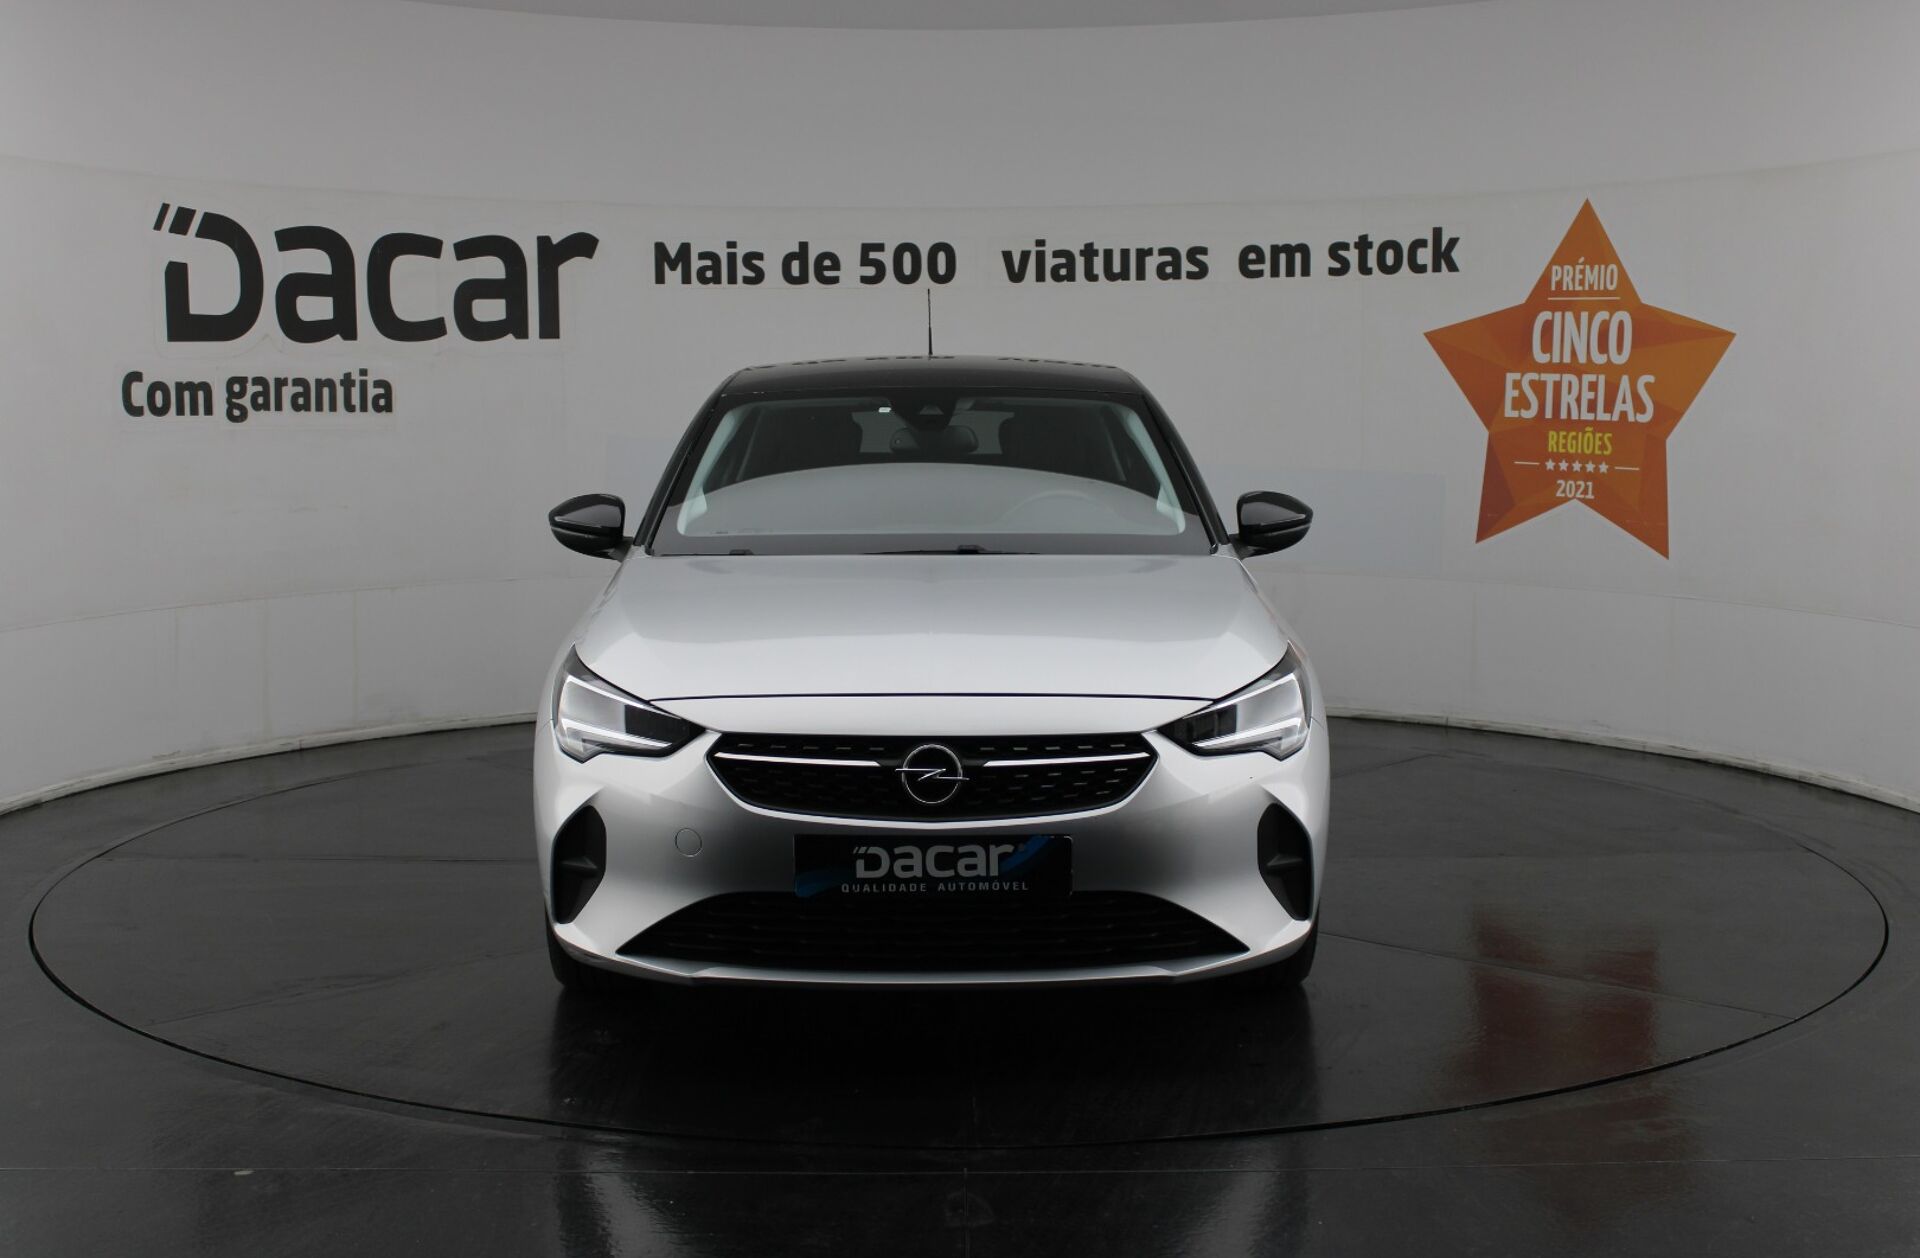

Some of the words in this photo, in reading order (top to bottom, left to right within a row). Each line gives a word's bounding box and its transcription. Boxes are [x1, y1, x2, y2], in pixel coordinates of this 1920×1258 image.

[153, 203, 599, 343] Dacar
[653, 241, 766, 285] Mais
[781, 241, 841, 285] de
[859, 241, 957, 285] 500
[1001, 239, 1209, 283] viaturas
[1238, 242, 1311, 279] em
[1327, 227, 1460, 276] stock
[1551, 257, 1618, 291] PRÉMIO
[1532, 311, 1633, 365] CINCO
[121, 371, 213, 417] Com
[225, 368, 393, 423] garantia
[1504, 372, 1655, 423] ESTRELAS
[1548, 426, 1613, 455] REGIÕES
[1556, 480, 1595, 499] 2021
[853, 845, 1014, 878] Dacar
[841, 883, 927, 893] QUALIDADE
[938, 879, 1029, 891] AUTOMÓVEL
